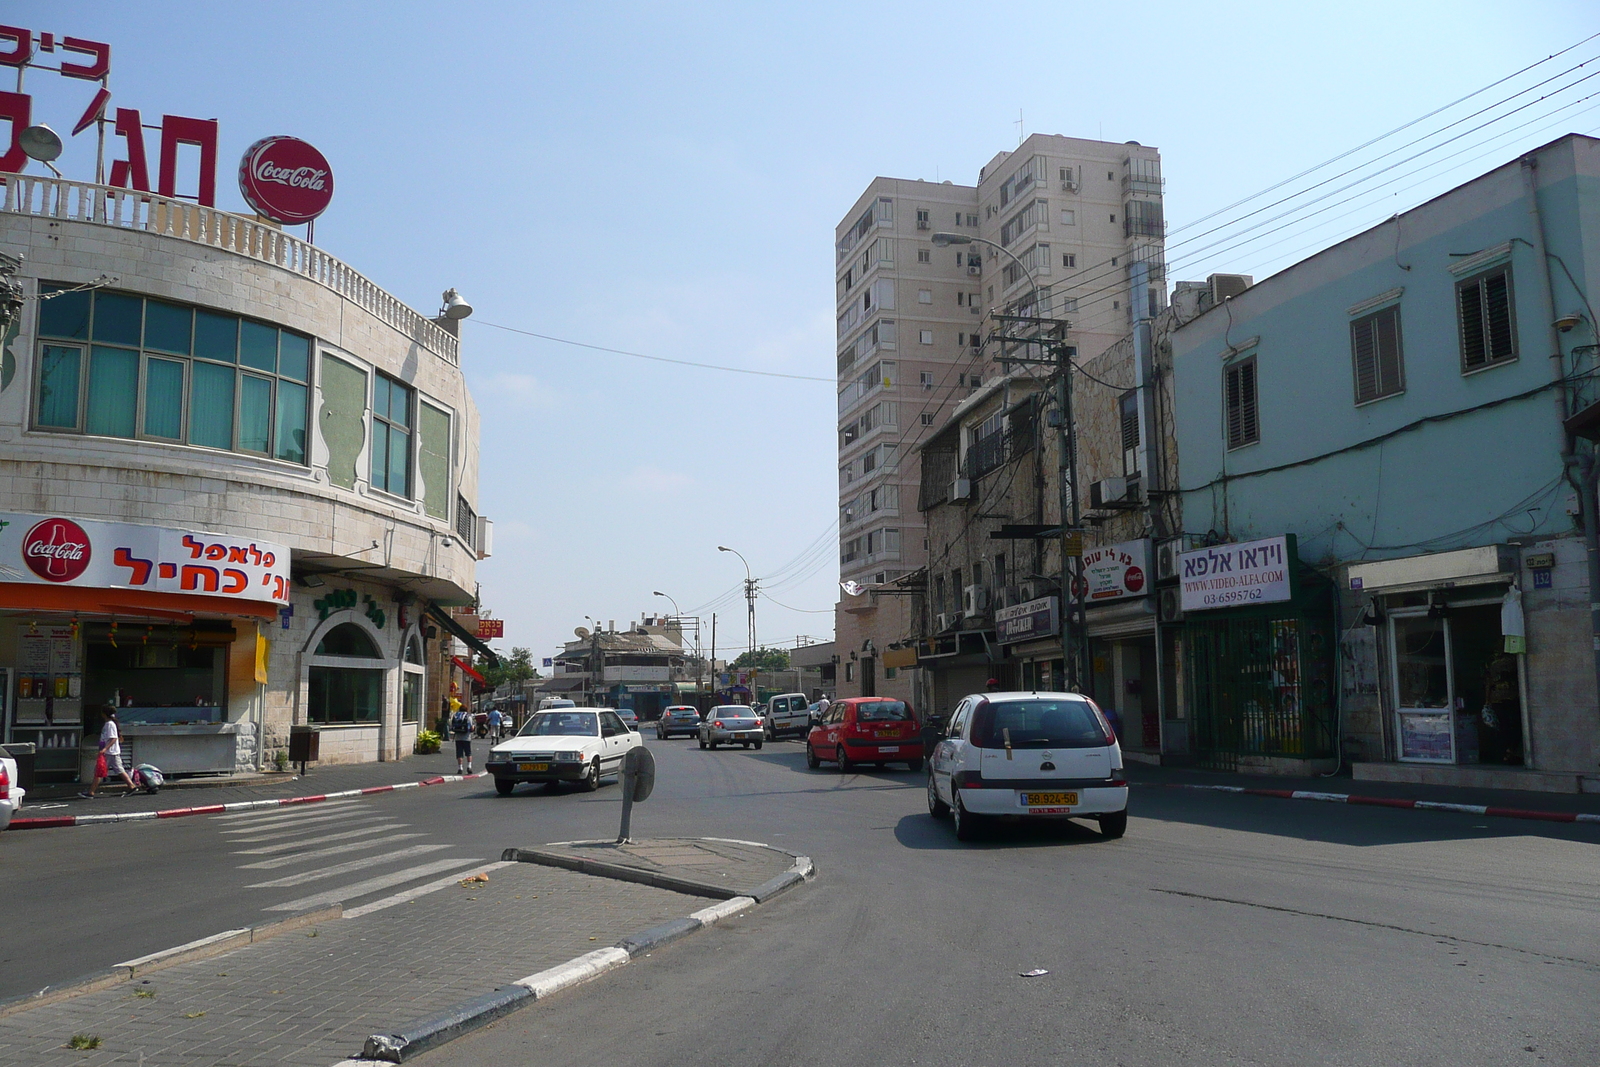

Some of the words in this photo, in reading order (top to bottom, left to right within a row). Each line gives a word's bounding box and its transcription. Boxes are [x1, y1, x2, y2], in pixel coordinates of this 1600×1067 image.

[257, 160, 327, 191] Coca-Cola
[27, 539, 86, 560] Coca-Cola
[182, 535, 276, 567] פלאפל
[1239, 544, 1282, 570] וידאו
[114, 547, 249, 594] כחיל
[1184, 550, 1232, 578] אלפא
[1184, 570, 1283, 593] WWW.VIDEO-ALFA.COM
[1535, 572, 1550, 585] 132
